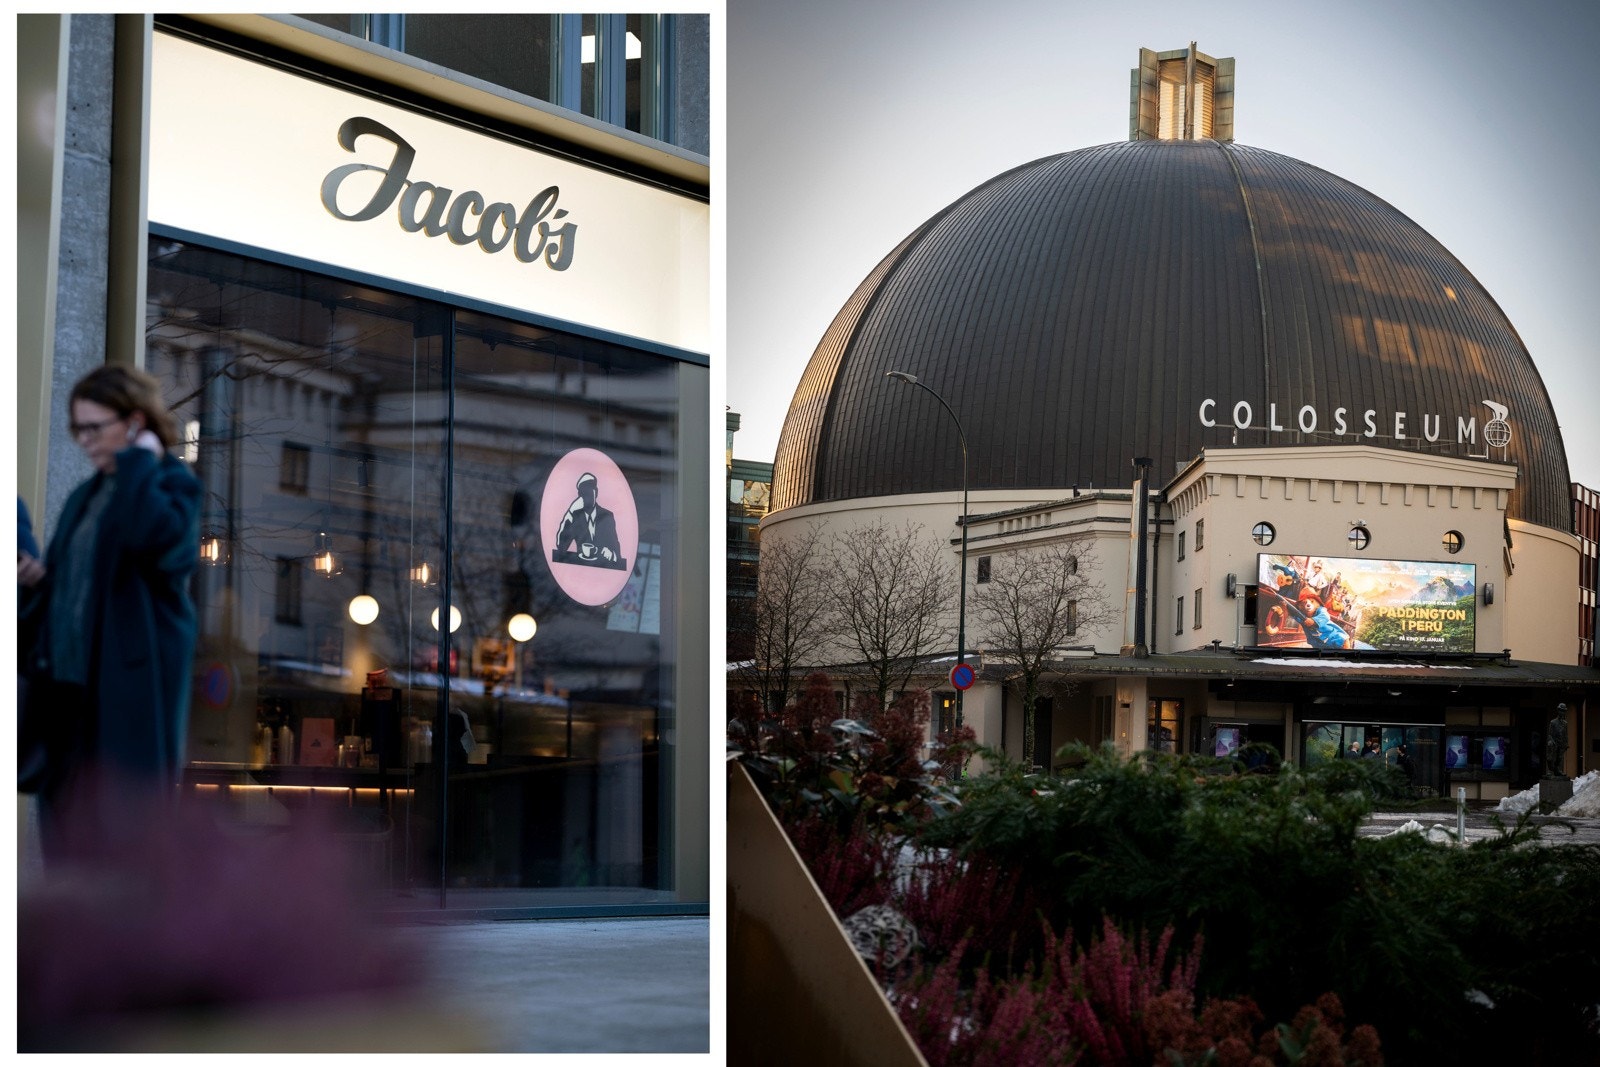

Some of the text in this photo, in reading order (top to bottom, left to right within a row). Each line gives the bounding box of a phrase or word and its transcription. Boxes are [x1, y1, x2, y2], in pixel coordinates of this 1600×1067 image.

[320, 116, 578, 272] Jacob's
[1199, 398, 1476, 445] COLOSSEUM
[1379, 607, 1466, 621] PADDINGTON
[1401, 620, 1443, 632] I PERU
